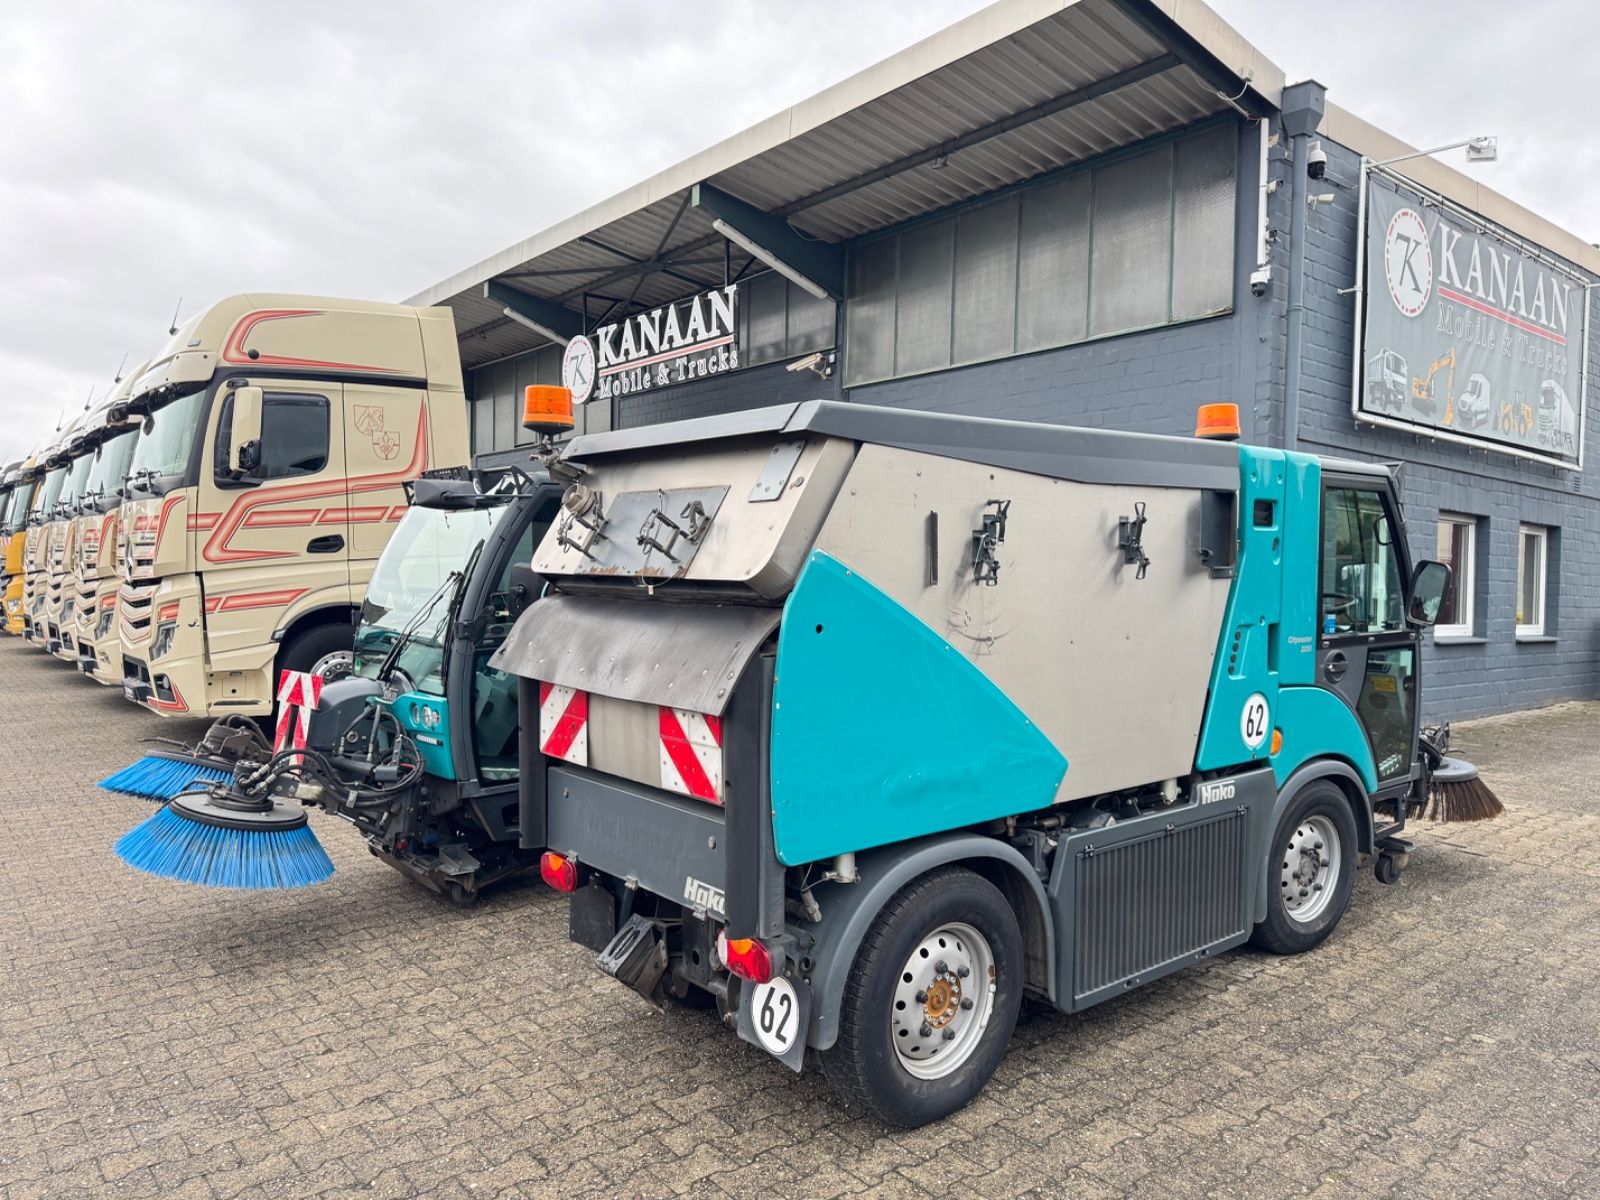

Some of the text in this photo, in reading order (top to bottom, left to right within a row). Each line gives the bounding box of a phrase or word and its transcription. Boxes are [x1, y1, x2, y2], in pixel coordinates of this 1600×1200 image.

[1438, 222, 1571, 334] KANAAN
[597, 284, 738, 368] KANAAN
[1437, 301, 1568, 377] Mobile & Trucks
[600, 346, 738, 399] Mobile & Trucks
[1246, 703, 1264, 738] 62
[1201, 780, 1235, 805] Hako
[761, 986, 792, 1044] 62
